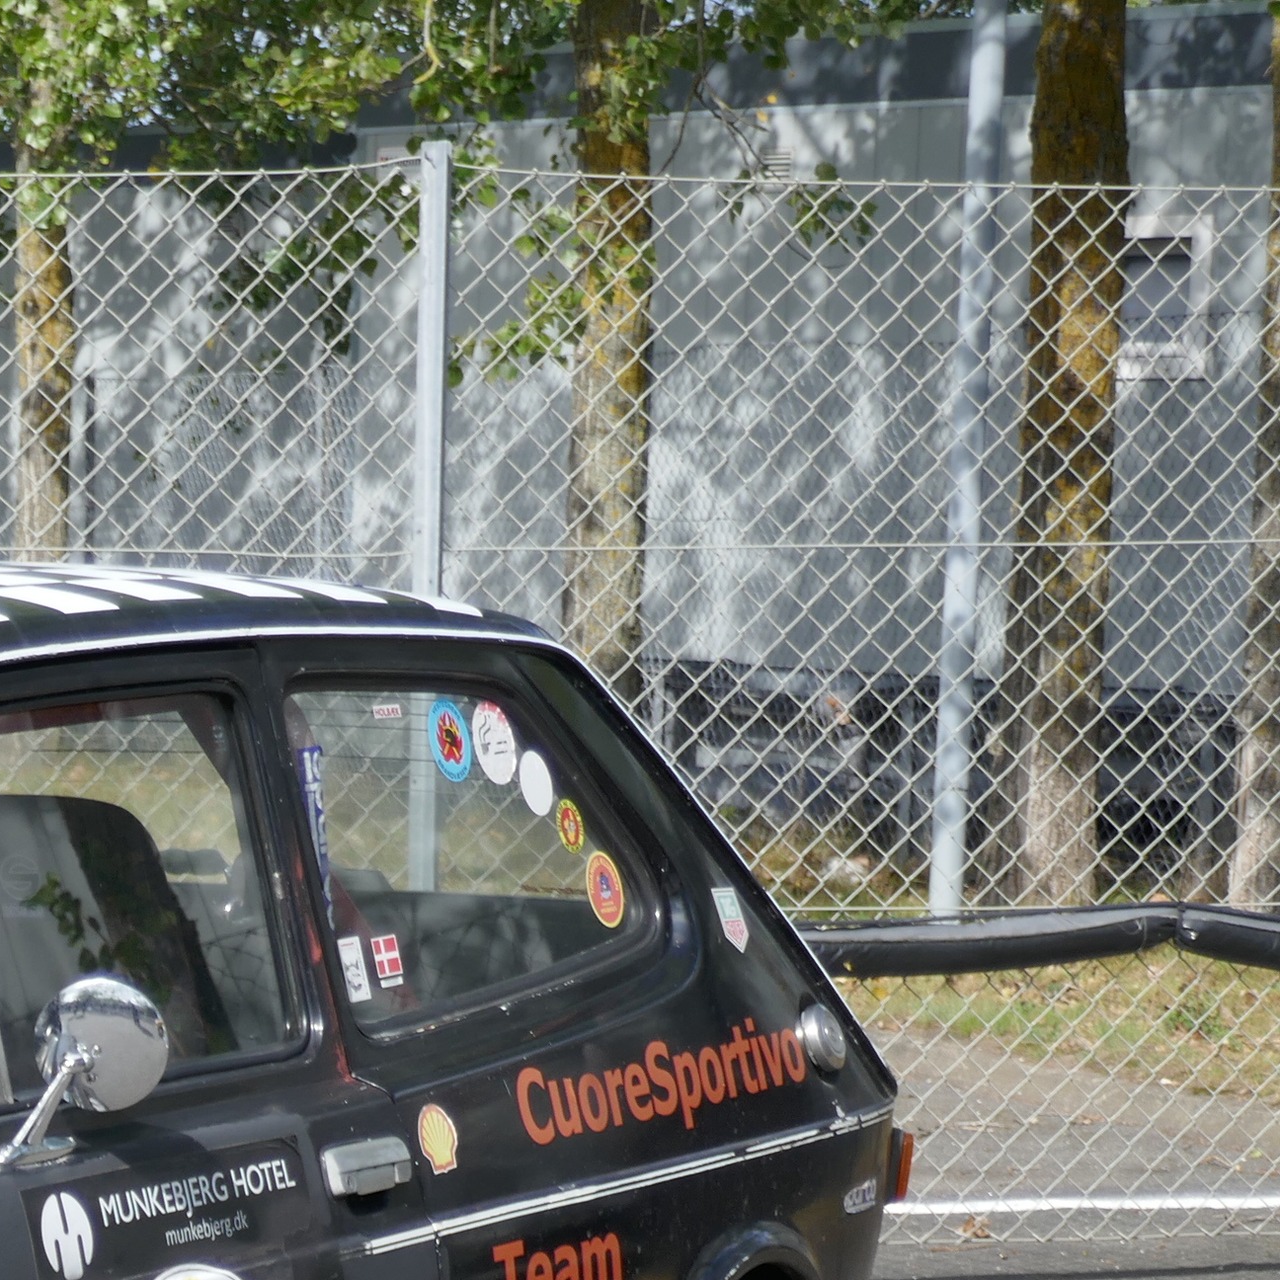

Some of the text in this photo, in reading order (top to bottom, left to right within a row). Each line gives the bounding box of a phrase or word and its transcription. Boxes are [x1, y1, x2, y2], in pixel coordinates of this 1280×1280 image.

[515, 1016, 807, 1146] CuoreSportivo
[98, 1159, 296, 1228] MUNKEBJERG HOTEL
[165, 1210, 249, 1247] munkebjerg.dk
